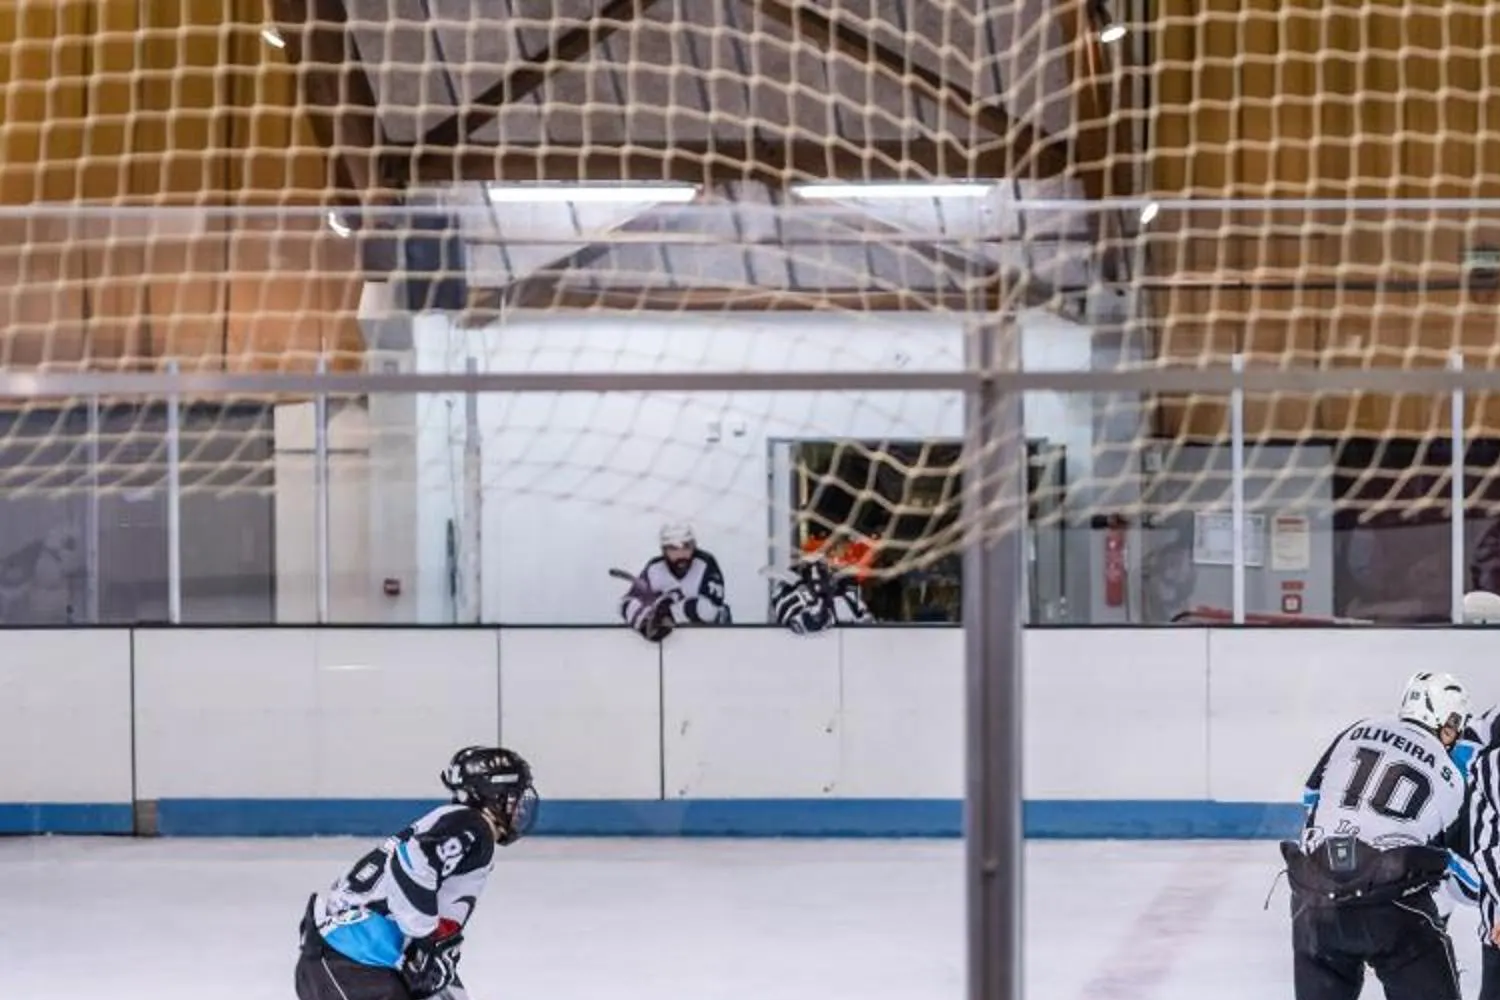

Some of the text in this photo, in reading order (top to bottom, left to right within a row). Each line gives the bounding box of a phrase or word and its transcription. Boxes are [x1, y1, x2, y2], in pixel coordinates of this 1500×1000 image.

[1339, 746, 1434, 822] 10
[1349, 726, 1455, 788] OLIVEIRA S.
